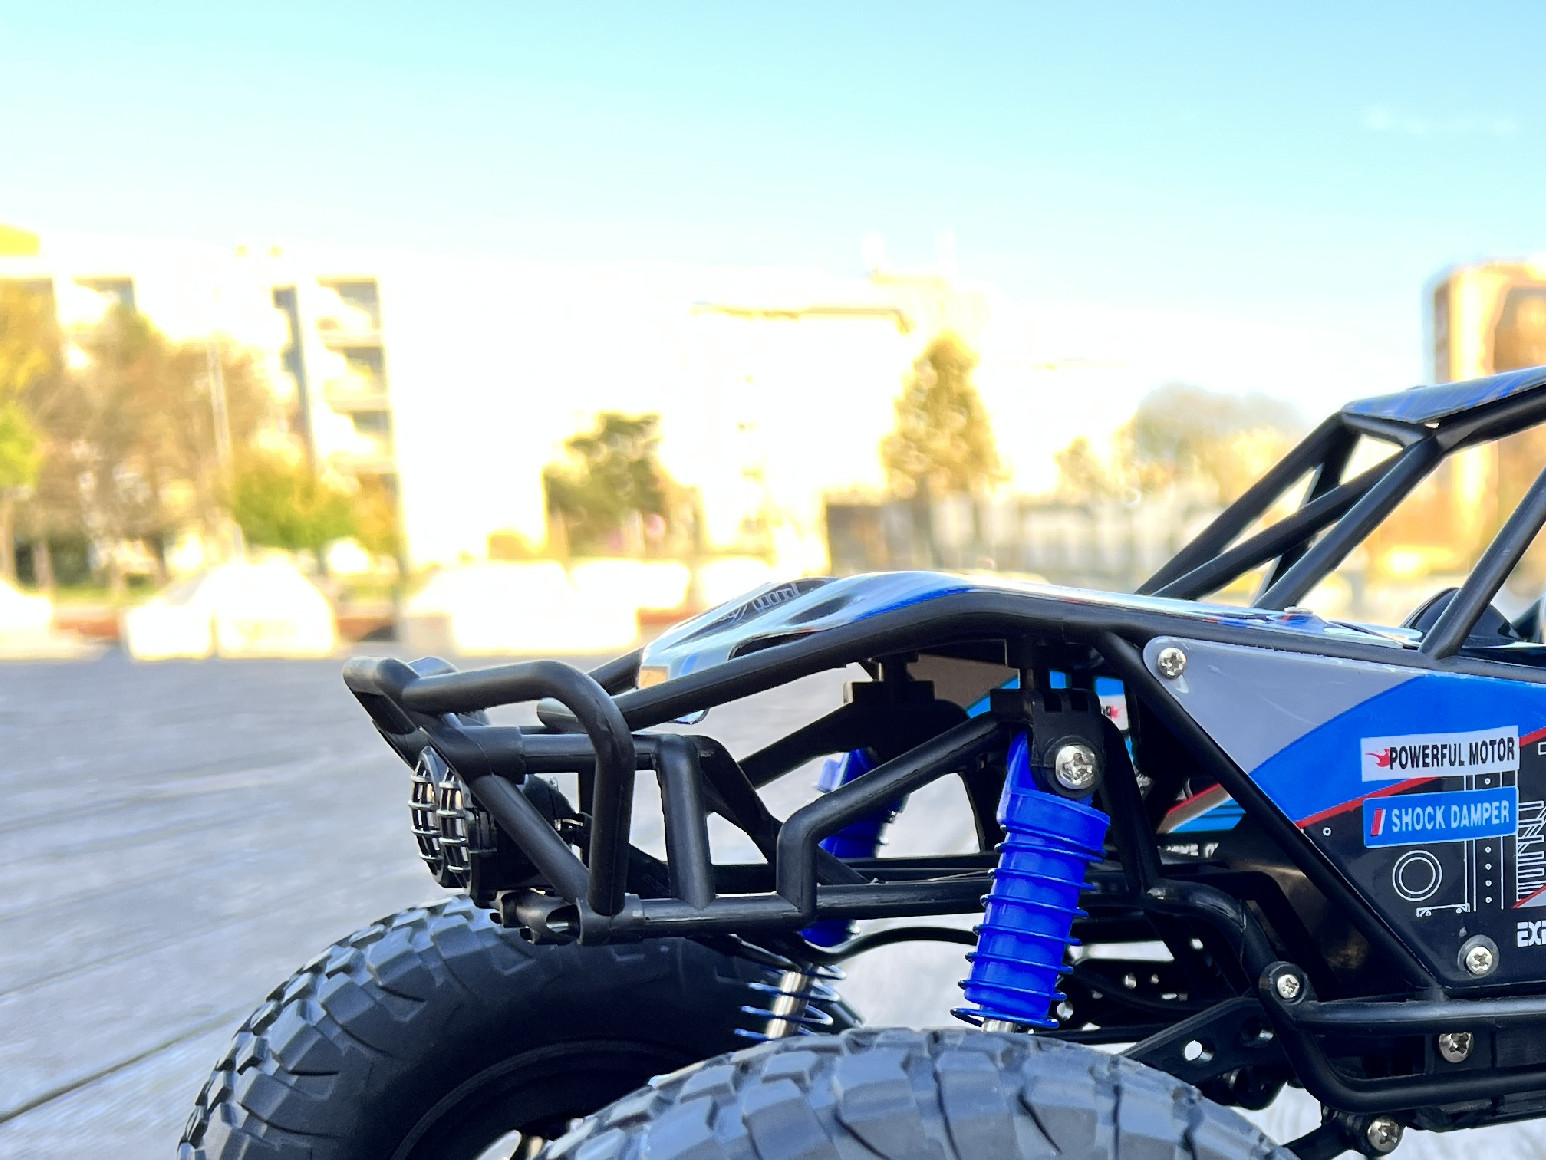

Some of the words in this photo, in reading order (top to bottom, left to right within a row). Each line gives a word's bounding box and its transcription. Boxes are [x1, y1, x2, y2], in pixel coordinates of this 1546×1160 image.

[1389, 743, 1465, 770] POWERFUL
[1469, 737, 1515, 766] MOTOR
[1391, 805, 1446, 833] SHOCK
[1450, 800, 1510, 829] DAMPER
